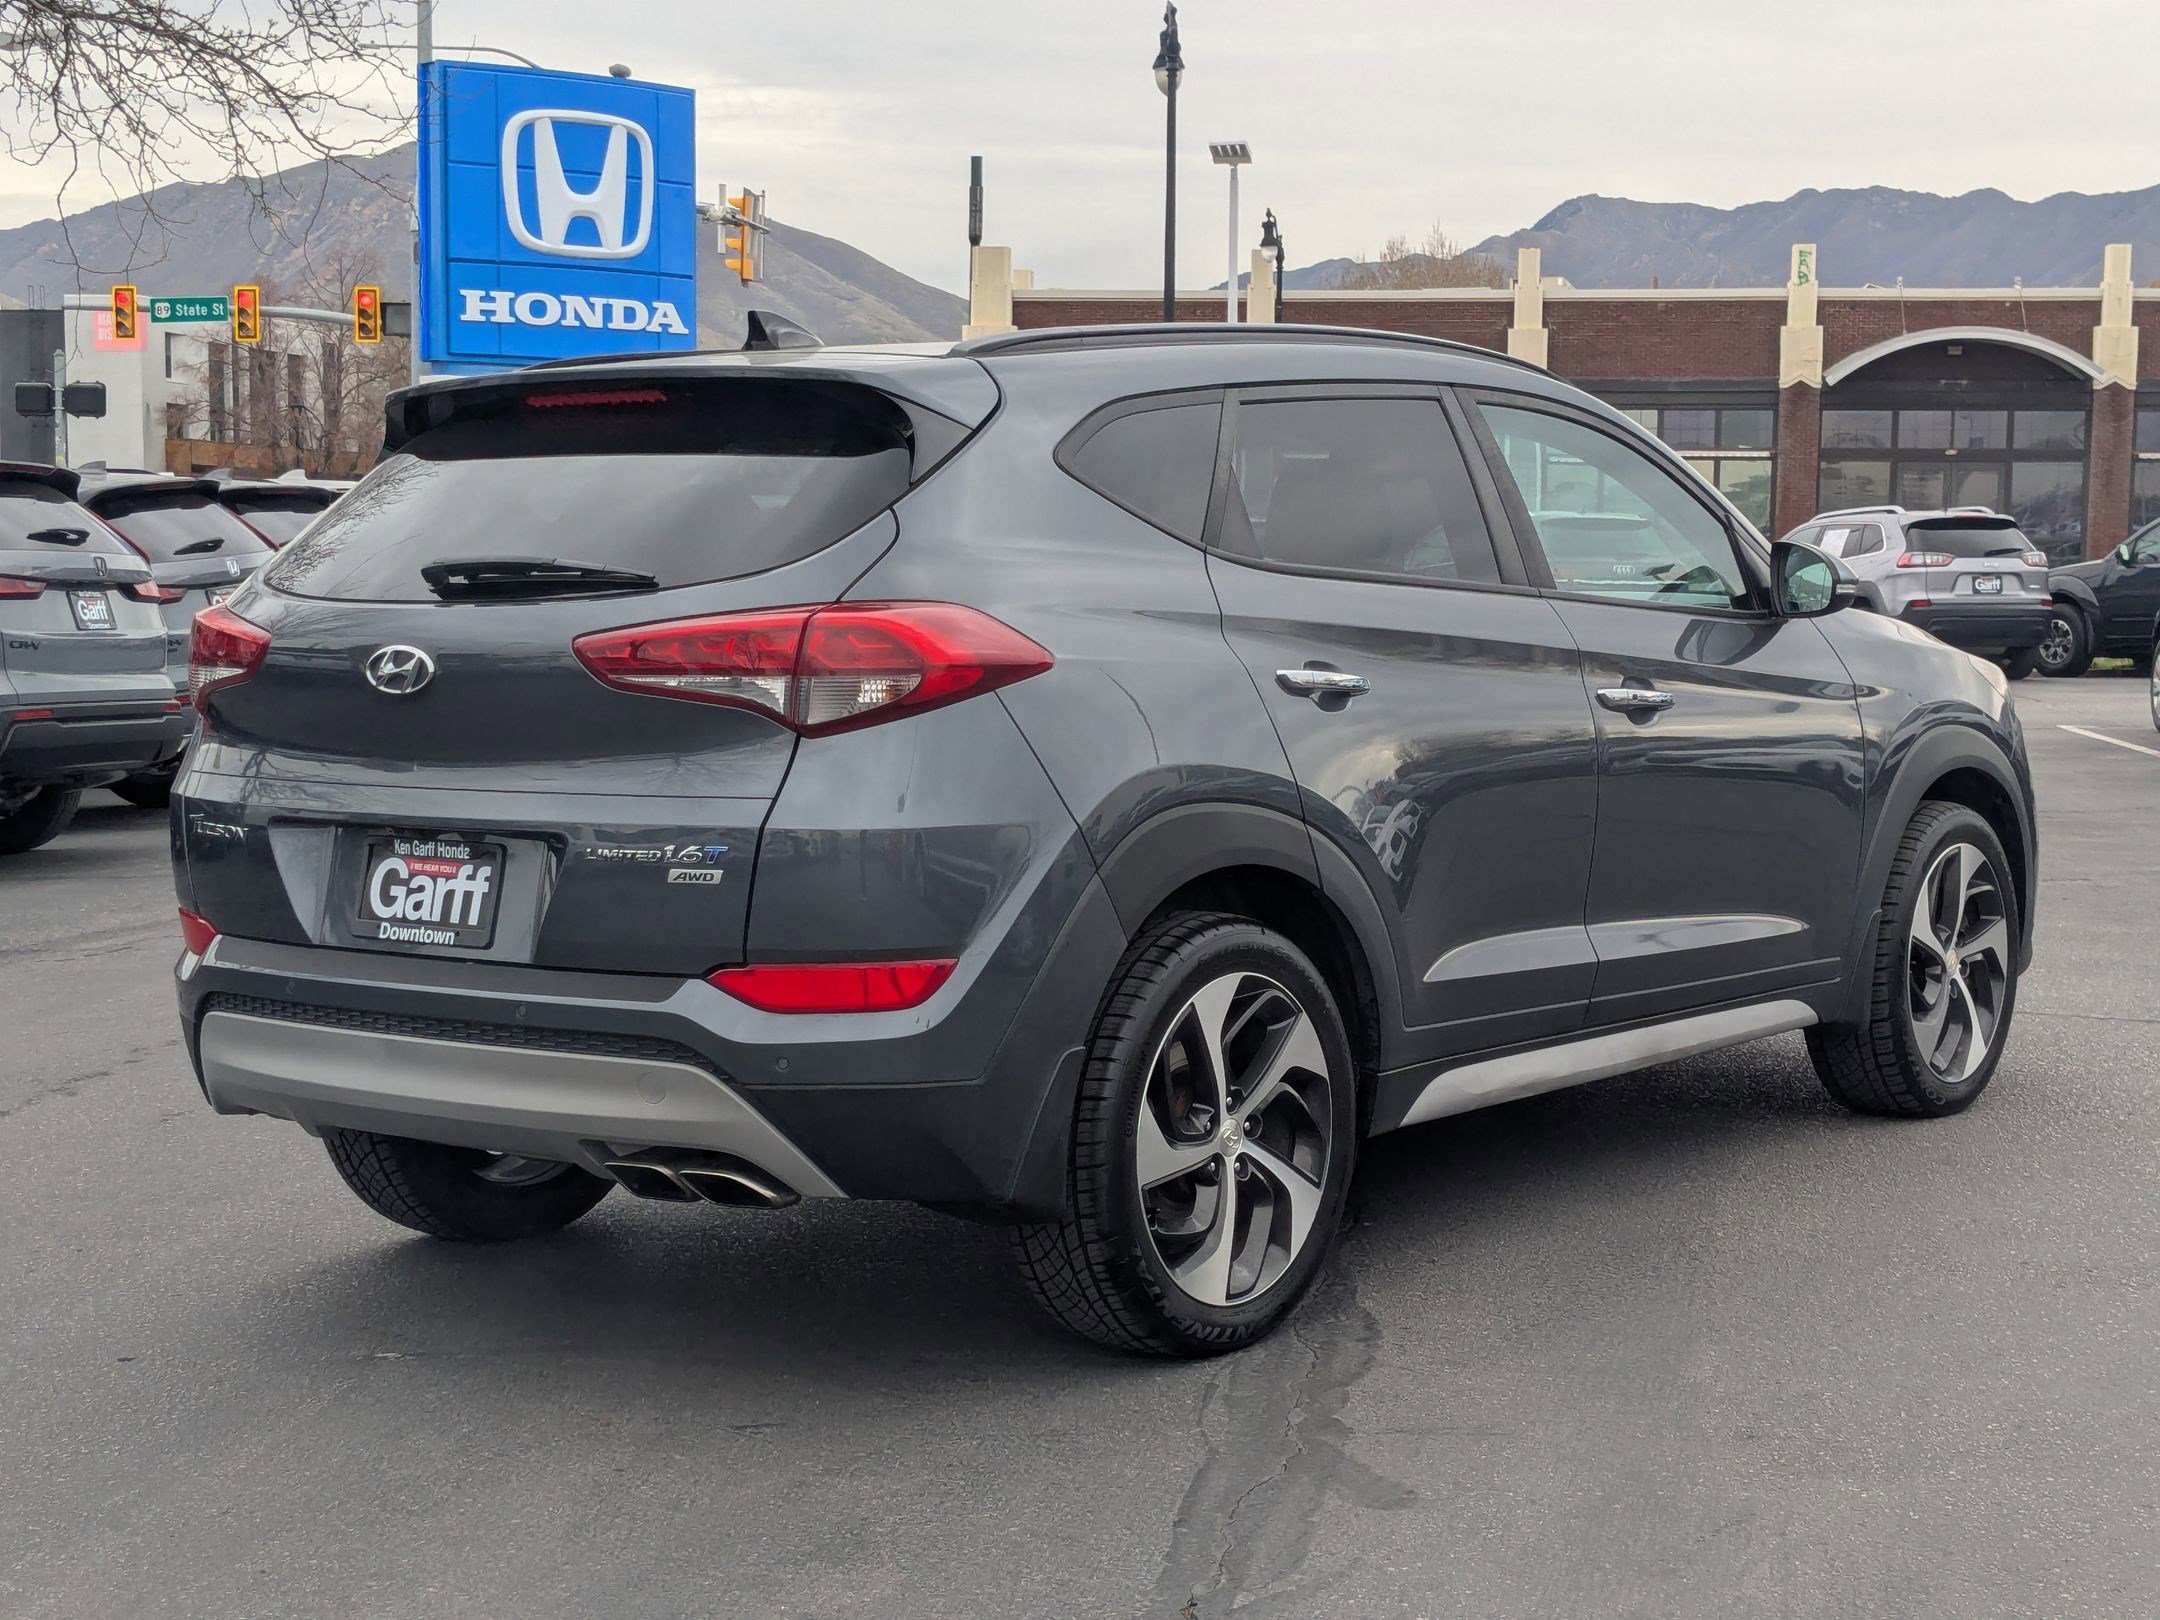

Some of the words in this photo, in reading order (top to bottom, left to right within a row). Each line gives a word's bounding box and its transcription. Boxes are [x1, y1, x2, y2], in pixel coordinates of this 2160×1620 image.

[156, 305, 170, 313] 89
[175, 304, 208, 316] State
[212, 303, 224, 315] St
[459, 288, 689, 334] HONDA
[78, 599, 108, 620] Garff
[394, 839, 411, 855] Ken
[412, 840, 435, 857] Garff
[437, 842, 471, 859] Honda
[584, 848, 661, 863] LIMITED
[673, 872, 715, 882] AWD
[370, 857, 492, 926] Garff
[379, 922, 456, 945] Downtown
